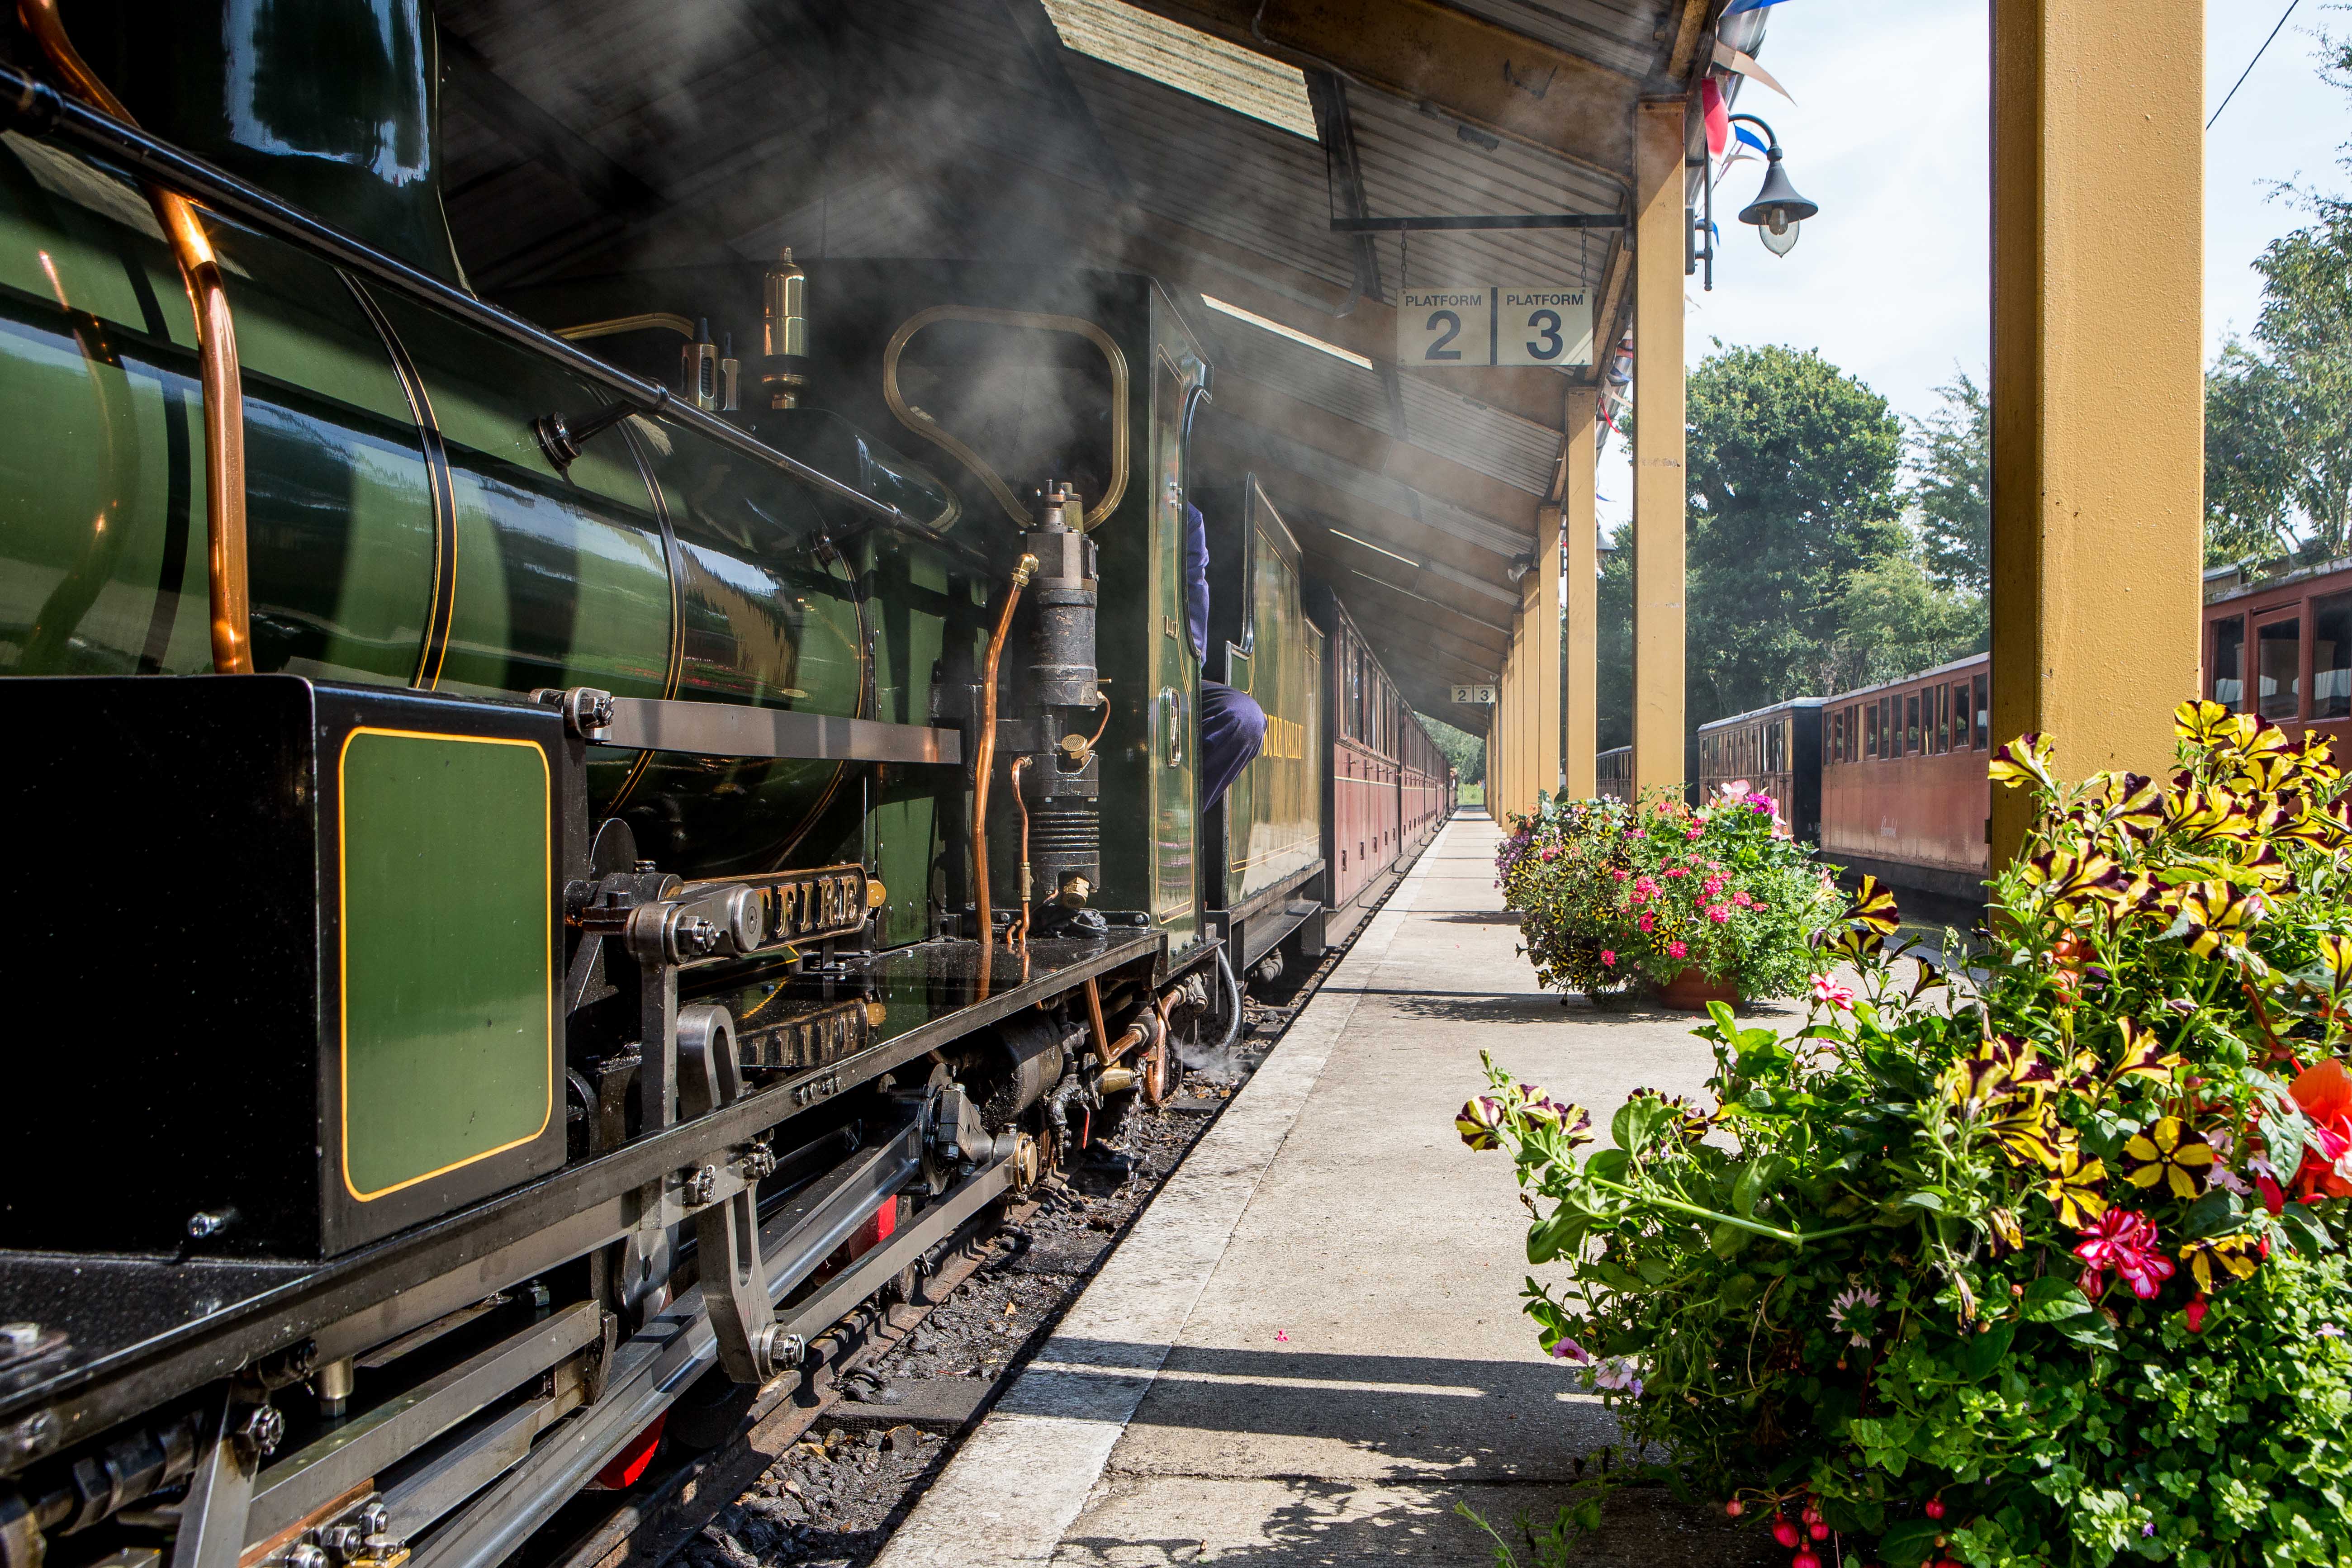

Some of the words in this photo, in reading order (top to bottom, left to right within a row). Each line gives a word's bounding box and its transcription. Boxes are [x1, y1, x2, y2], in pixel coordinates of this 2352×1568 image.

[1405, 295, 1482, 307] PLATFORM
[1507, 294, 1584, 306] PLATFORM
[1425, 309, 1461, 360] 2
[1526, 309, 1564, 360] 3
[1458, 690, 1466, 701] 2
[1480, 690, 1489, 701] 3
[1285, 720, 1303, 759] VALLE
